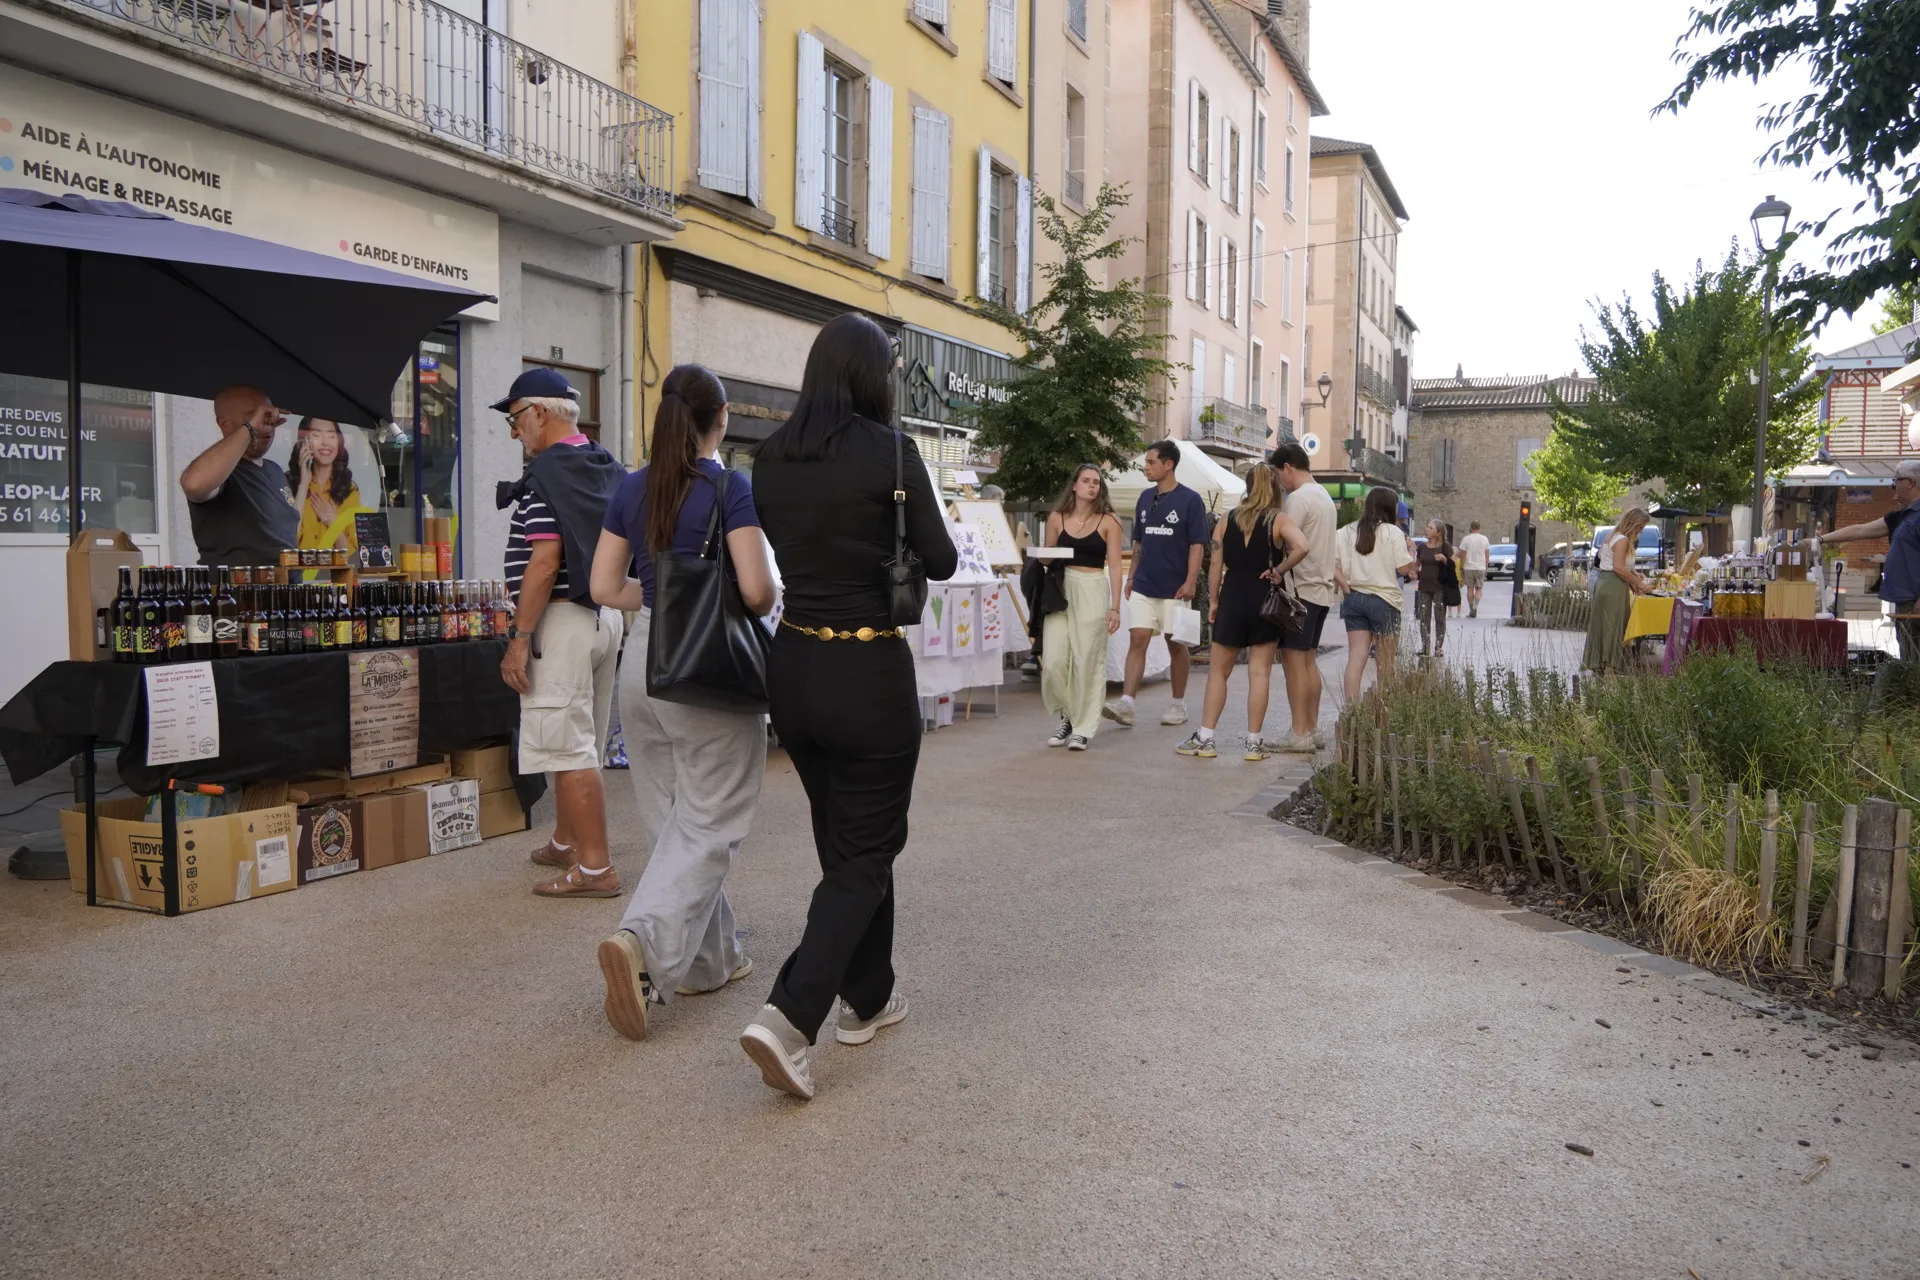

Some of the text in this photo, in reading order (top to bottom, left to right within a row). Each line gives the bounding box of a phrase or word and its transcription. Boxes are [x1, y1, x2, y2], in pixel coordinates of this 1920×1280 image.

[21, 122, 221, 190] AIDE À L'AUTONOMIE
[22, 158, 233, 226] MÉNAGE & REPASSAGE
[353, 242, 469, 282] GARDE D'ENFANTS
[554, 347, 560, 360] 5
[948, 371, 986, 402] Refuge
[25, 409, 62, 423] DEVIS
[16, 425, 36, 437] OU
[40, 426, 56, 439] EN
[61, 428, 96, 441] LNE
[13, 507, 31, 523] 61
[38, 507, 61, 523] 46
[371, 670, 408, 688] MOUSSE
[132, 841, 163, 857] RAGILE
